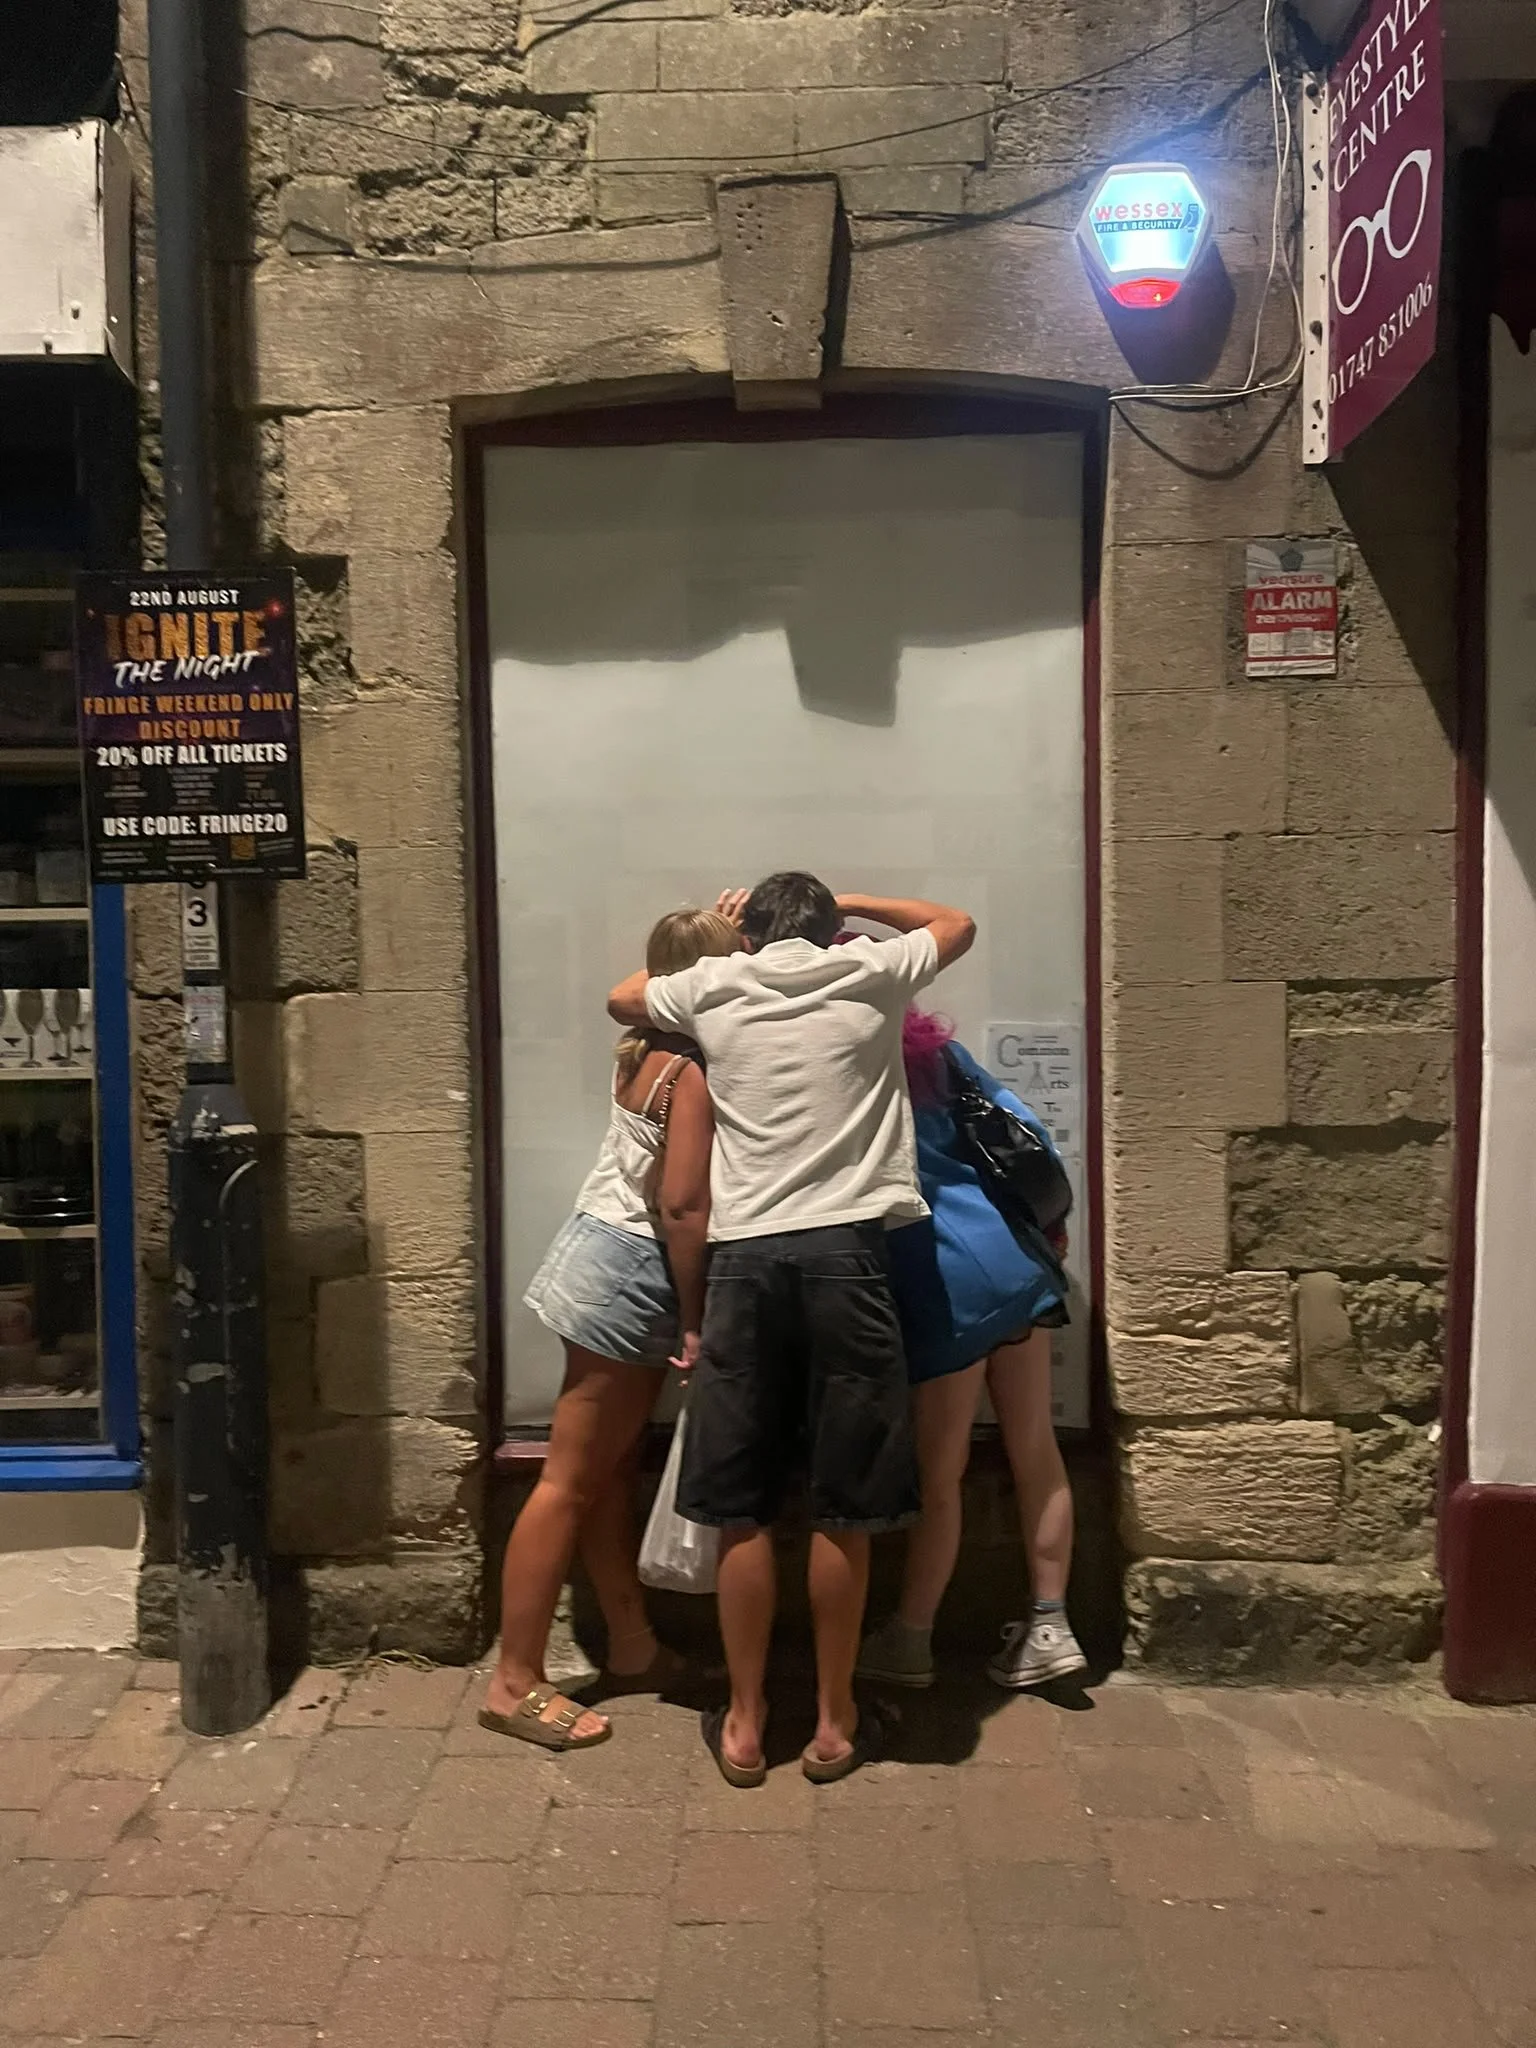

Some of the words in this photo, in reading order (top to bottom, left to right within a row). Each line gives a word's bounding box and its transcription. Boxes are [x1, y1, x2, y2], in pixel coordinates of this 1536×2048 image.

[1334, 40, 1426, 192] CENTRE
[1095, 202, 1183, 221] wessex
[1097, 223, 1118, 232] FIRE
[1132, 220, 1178, 230] SECURITY
[1328, 336, 1375, 404] 01747
[1378, 271, 1433, 357] 851006
[129, 590, 173, 606] 22ND
[177, 589, 240, 605] AUGUST
[1252, 591, 1333, 611] ALARM
[104, 610, 269, 661] IGNITE
[113, 661, 168, 688] THE
[83, 696, 151, 714] FRINGE
[155, 694, 243, 712] WEEKEND
[250, 692, 294, 710] ONLY
[138, 720, 241, 739] DISCOUNT
[96, 746, 138, 766] 20%
[140, 745, 174, 765] OFF
[176, 744, 209, 764] ALL
[210, 743, 288, 763] TICKETS
[102, 817, 140, 836] USE
[142, 815, 197, 835] CODE:
[199, 813, 288, 834] FRINGE20
[188, 900, 207, 927] 3
